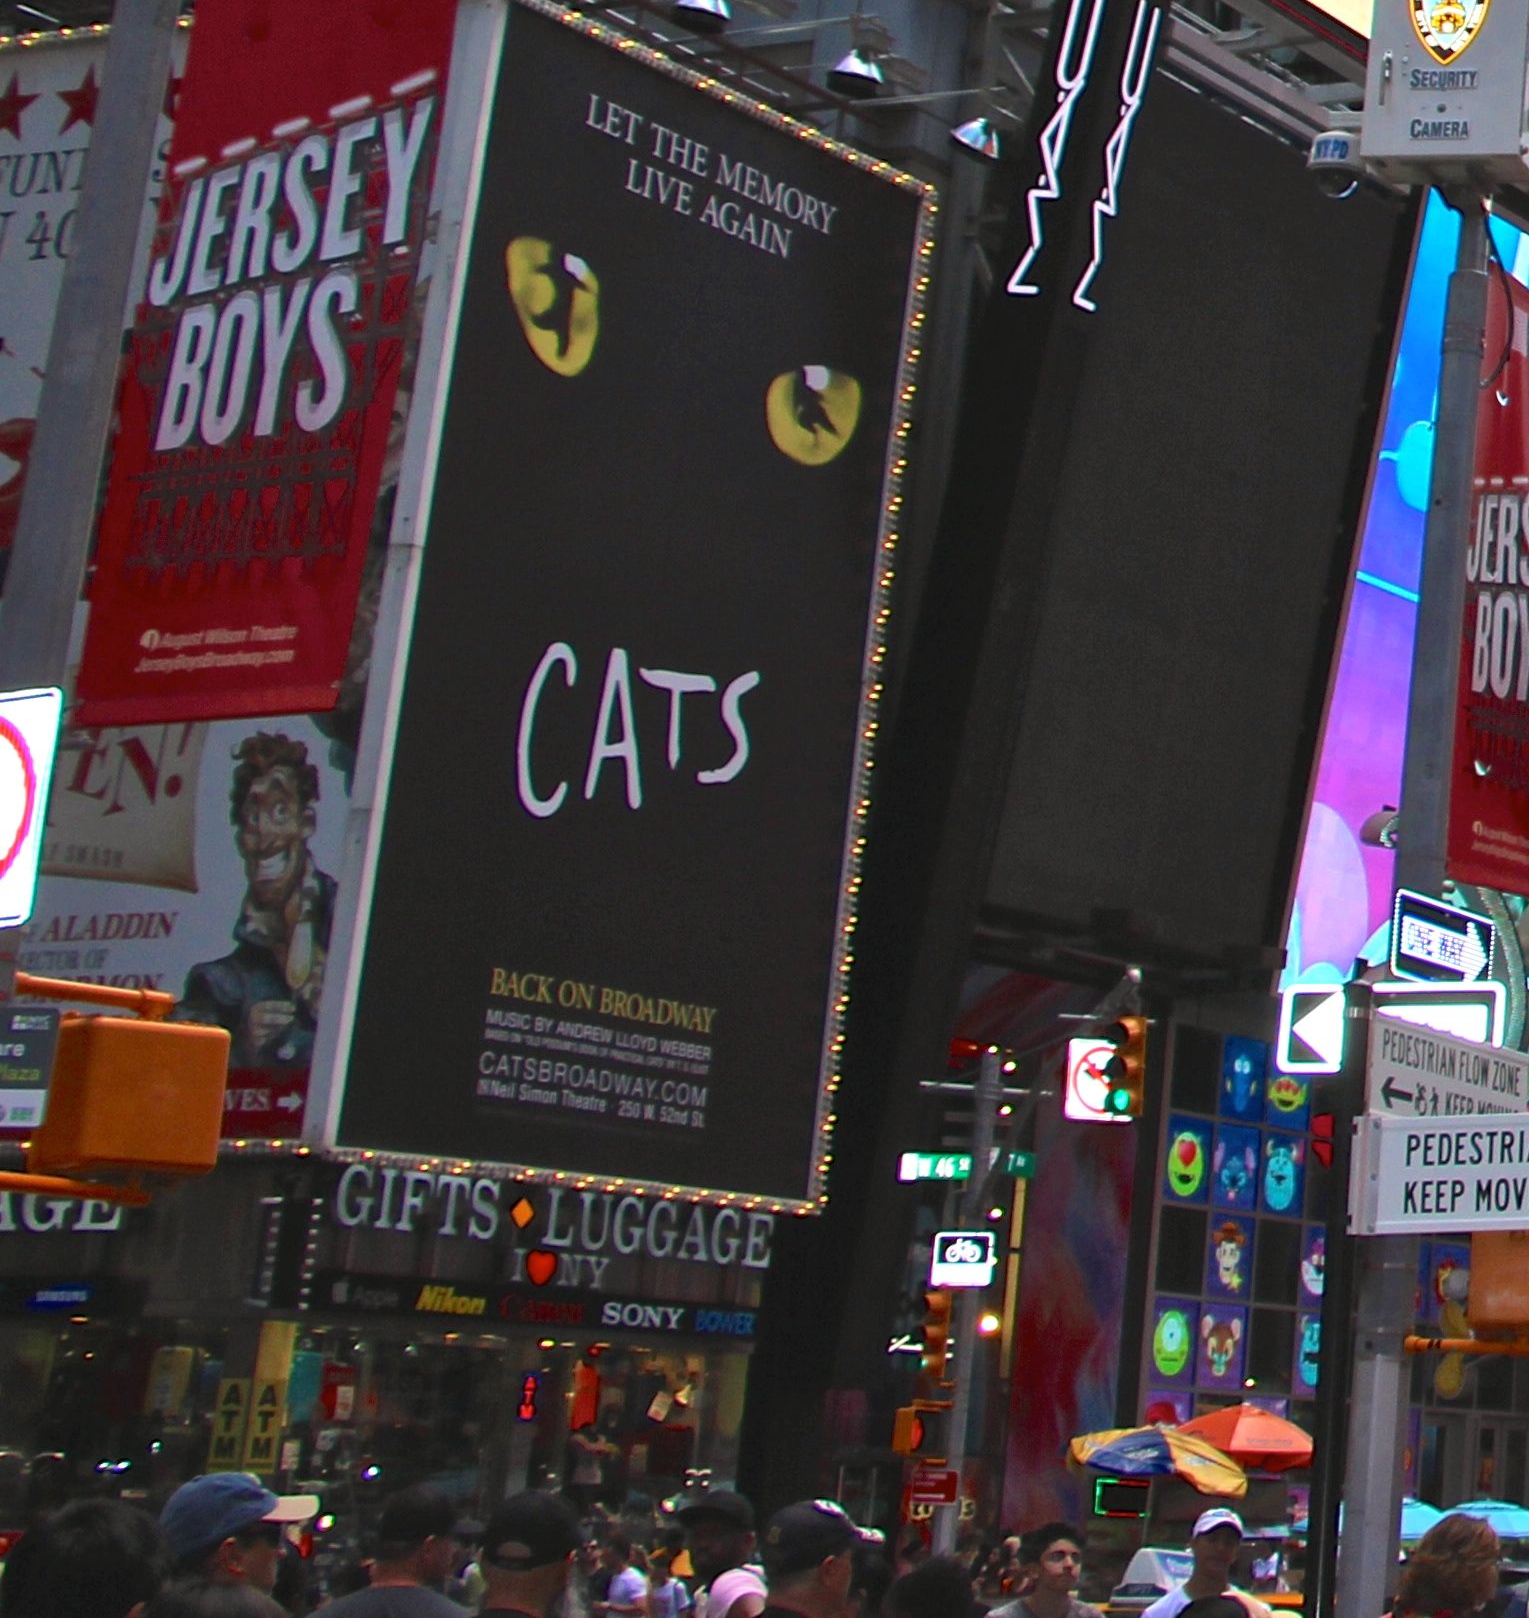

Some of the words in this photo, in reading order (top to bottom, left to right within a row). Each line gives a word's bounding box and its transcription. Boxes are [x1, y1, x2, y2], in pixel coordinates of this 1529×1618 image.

[1409, 68, 1478, 90] SECURITY
[1312, 138, 1350, 162] NYPD
[1409, 118, 1470, 140] CAMERA
[585, 93, 644, 146] LET
[650, 122, 709, 178] THE
[715, 153, 838, 235] MEMORY
[151, 97, 434, 308] JERSEY
[625, 158, 694, 216] LIVE
[699, 194, 793, 260] AGAIN
[155, 269, 360, 451] BOYS
[516, 641, 760, 819] CATS
[41, 911, 180, 942] ALADDIN
[490, 967, 555, 1004] BACK
[558, 979, 596, 1010] ON
[599, 987, 717, 1034] BROADWAY
[485, 1008, 532, 1031] MUSIC
[533, 1016, 554, 1033] BY
[555, 1019, 614, 1044] ANDREW
[615, 1031, 657, 1053] LLOYD
[659, 1038, 712, 1061] WEBBER
[478, 1050, 708, 1108] CATSBROADWAY.COM
[1382, 1027, 1457, 1079] PEDESTRIAN
[1457, 1048, 1490, 1087] FLOW
[1491, 1061, 1522, 1099] ZONE
[518, 1083, 557, 1105] Simon
[561, 1089, 607, 1113] Theatre
[617, 1100, 641, 1119] 250
[659, 1106, 688, 1126] 52nd
[934, 1157, 956, 1179] 46
[335, 1162, 502, 1241] GIFTS
[541, 1186, 776, 1271] LUGGAGE
[1403, 1178, 1466, 1215] KEEP
[556, 1251, 610, 1291] NY
[415, 1283, 487, 1317] Nikon
[601, 1300, 686, 1331] SONY
